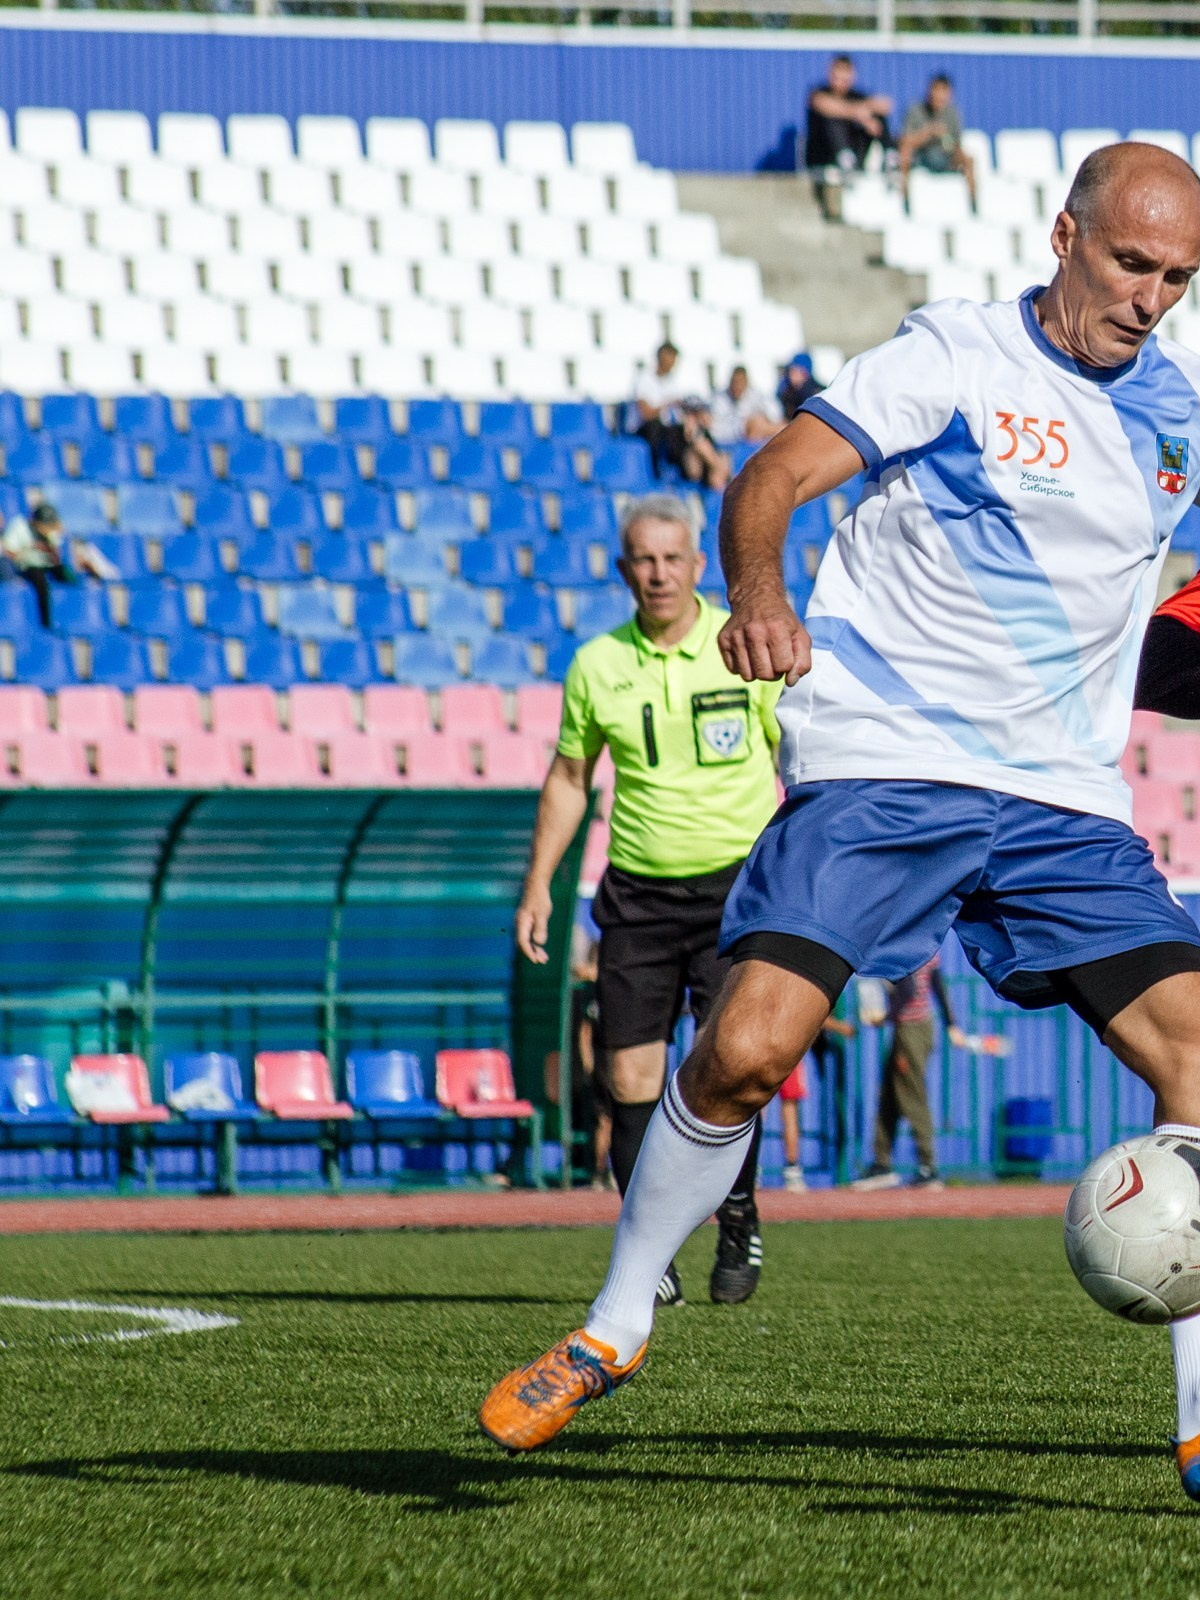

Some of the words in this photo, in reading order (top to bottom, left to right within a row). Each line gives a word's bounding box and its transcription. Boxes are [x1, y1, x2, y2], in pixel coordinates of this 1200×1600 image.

[995, 411, 1069, 469] 355
[1020, 472, 1060, 484] Усолье-
[1019, 482, 1075, 497] Сибирское
